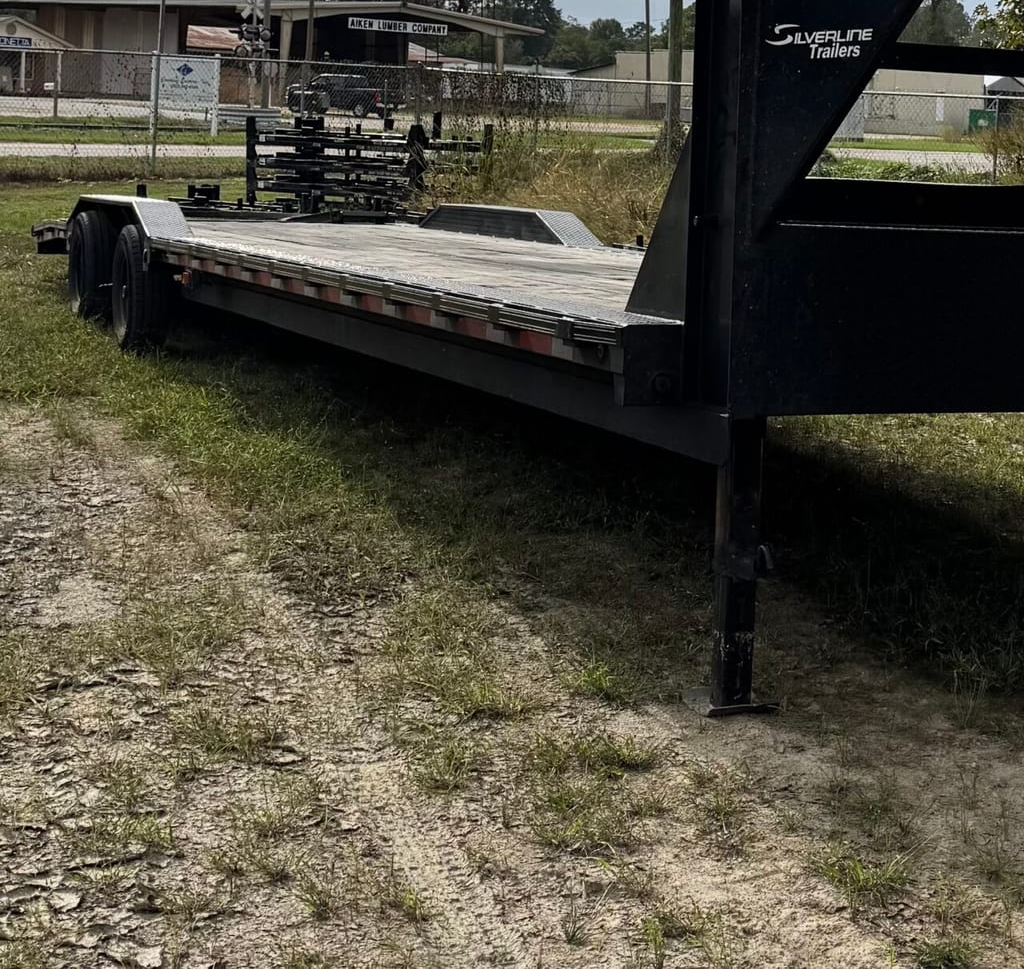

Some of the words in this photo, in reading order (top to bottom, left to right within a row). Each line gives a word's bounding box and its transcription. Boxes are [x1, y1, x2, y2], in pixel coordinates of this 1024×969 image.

[350, 18, 374, 29] AIKEN
[377, 20, 408, 32] LUMBER
[411, 23, 447, 35] COMPANY
[765, 24, 874, 46] SILVERLINE
[809, 42, 861, 59] Trailers
